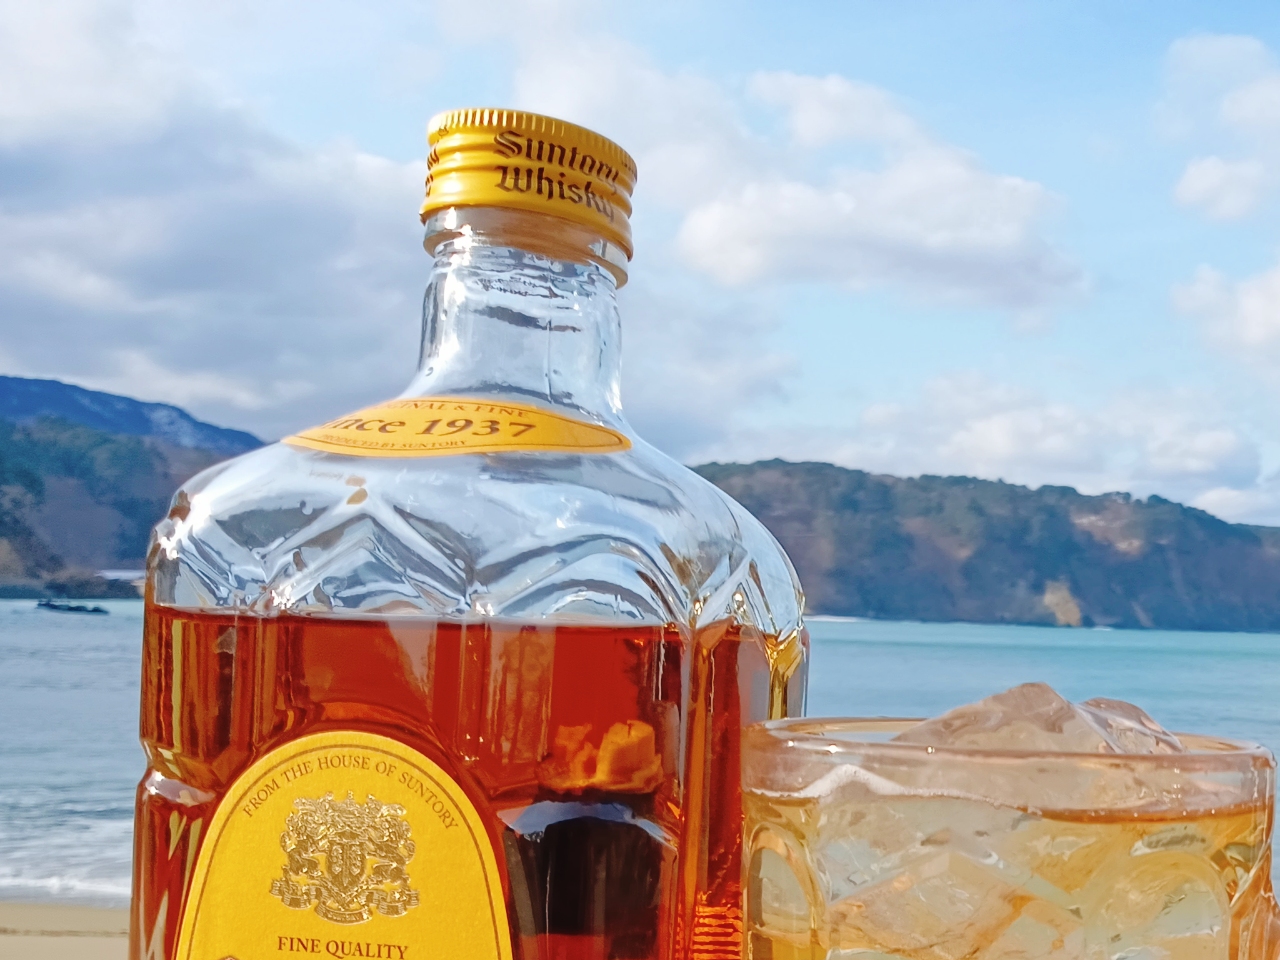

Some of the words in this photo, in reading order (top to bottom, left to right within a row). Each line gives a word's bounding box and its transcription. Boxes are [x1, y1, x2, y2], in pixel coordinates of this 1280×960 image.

[494, 130, 620, 196] Suntory
[494, 165, 615, 222] Whisky
[401, 440, 467, 448] SUNTORY
[415, 418, 537, 438] 1937
[242, 778, 280, 818] FROM
[280, 760, 314, 783] THE
[317, 755, 371, 771] HOUSE
[375, 761, 397, 777] OF
[398, 771, 459, 831] SUNTORY
[277, 935, 322, 954] FINE
[325, 939, 409, 960] QUALITY
